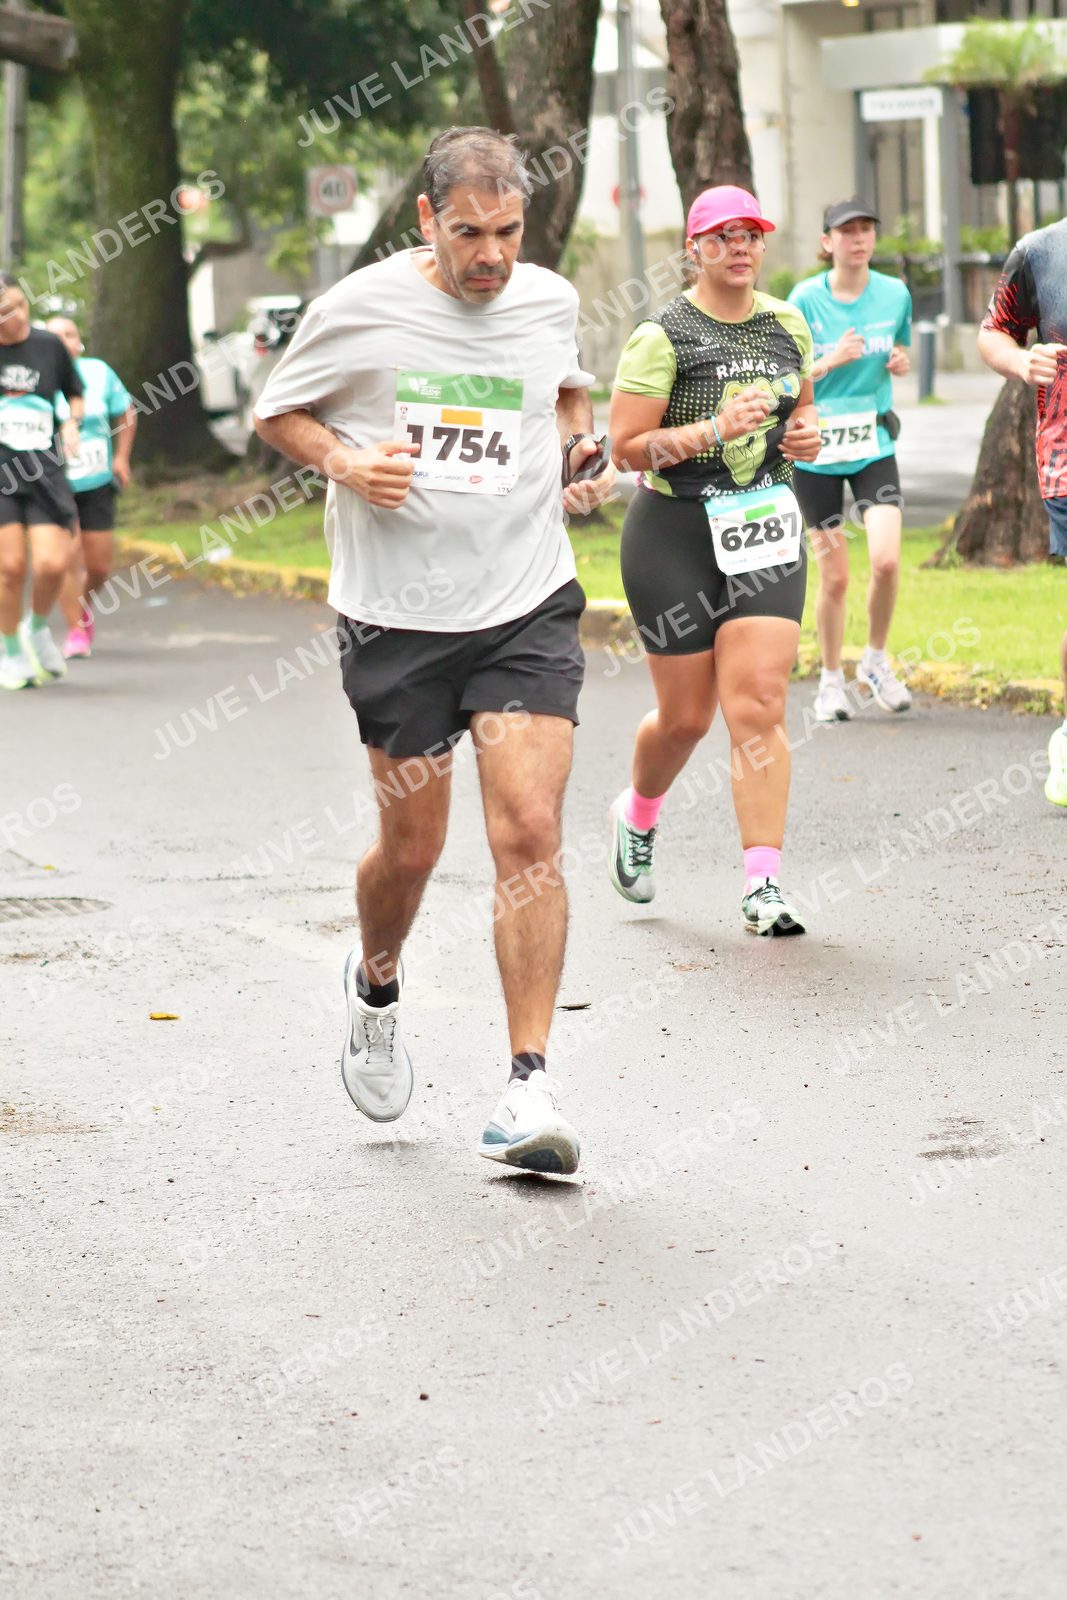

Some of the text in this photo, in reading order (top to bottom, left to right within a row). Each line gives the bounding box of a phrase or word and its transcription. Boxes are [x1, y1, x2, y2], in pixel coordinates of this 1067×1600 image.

[716, 359, 780, 380] RANAS
[407, 424, 511, 466] 1754
[820, 424, 872, 447] 5752
[721, 512, 798, 552] 6287
